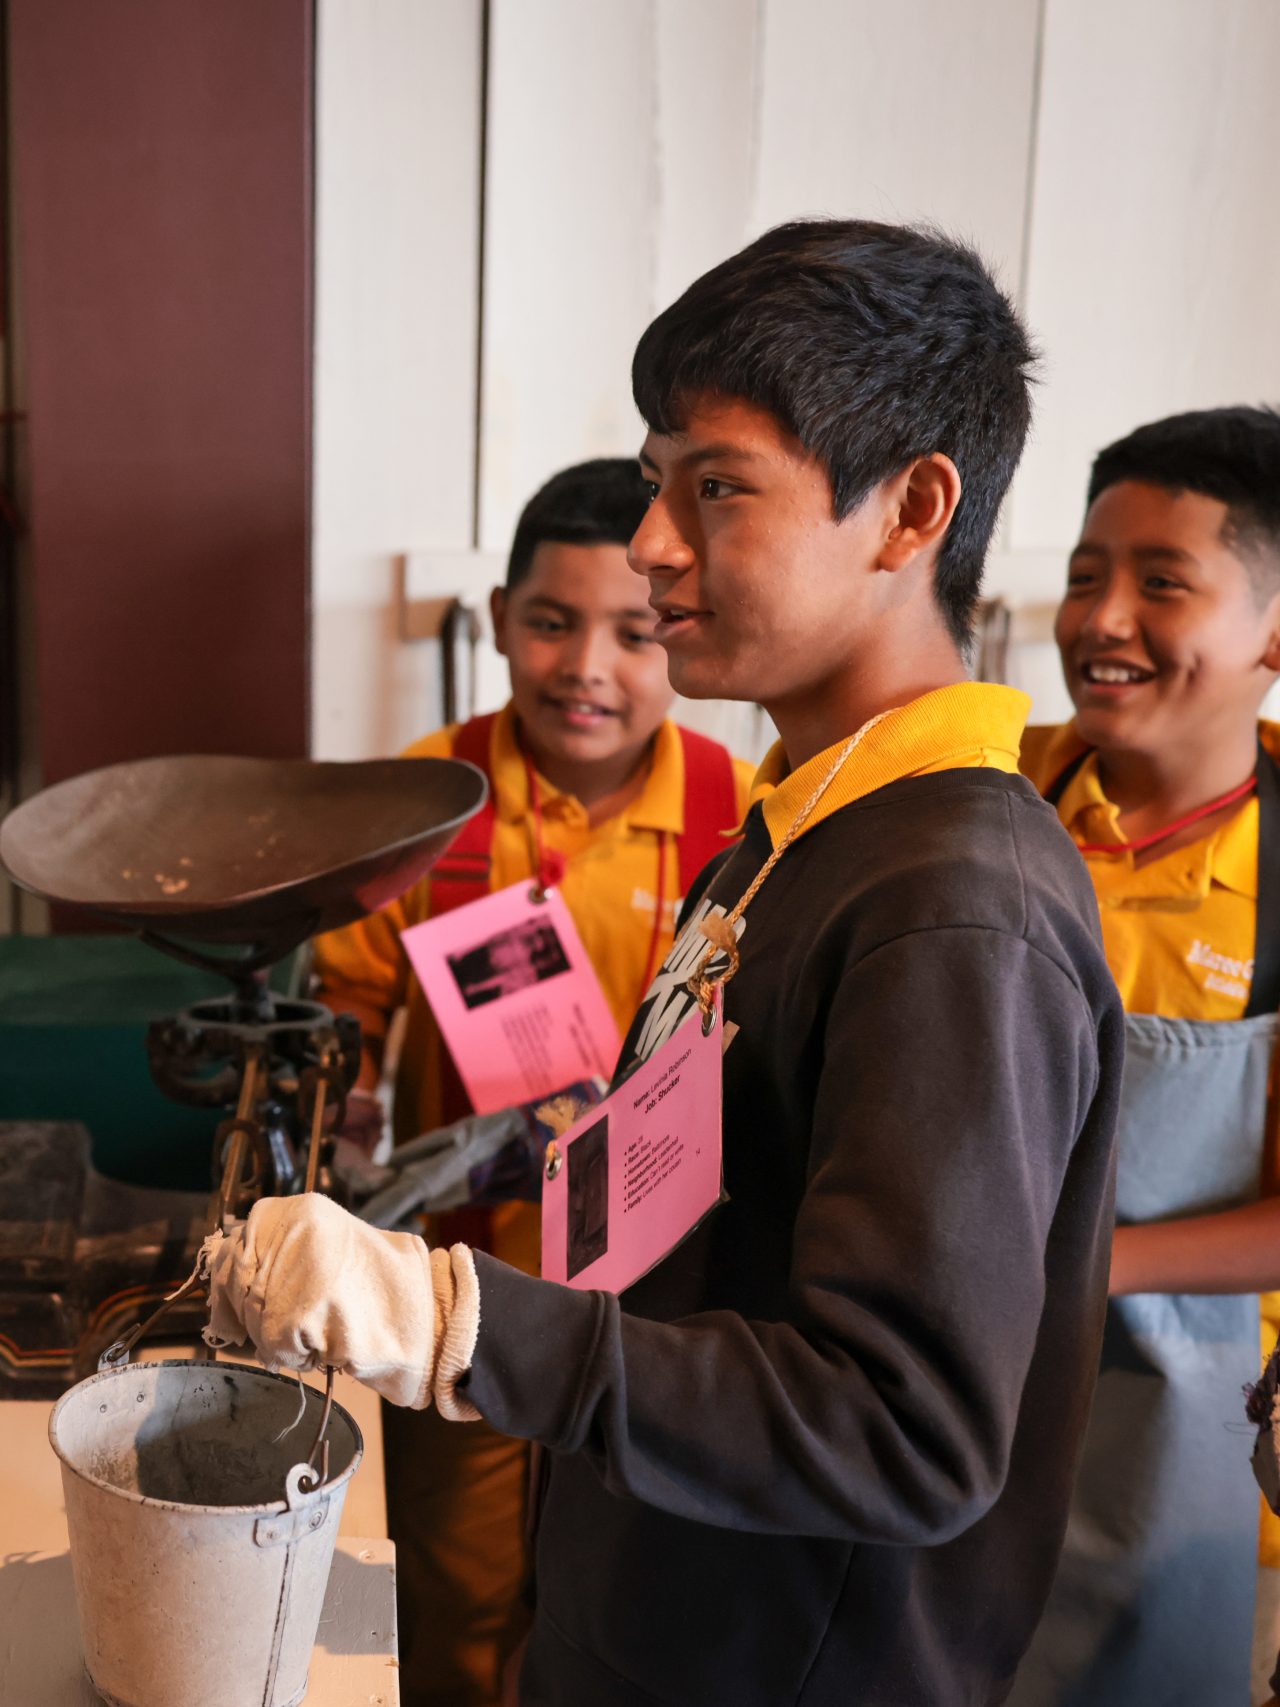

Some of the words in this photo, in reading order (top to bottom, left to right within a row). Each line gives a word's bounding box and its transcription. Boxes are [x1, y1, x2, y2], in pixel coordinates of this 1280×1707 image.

[634, 1090, 650, 1110] Name:
[669, 1048, 692, 1075] Robinson
[645, 1098, 657, 1114] Job:
[658, 1074, 681, 1101] Shucker
